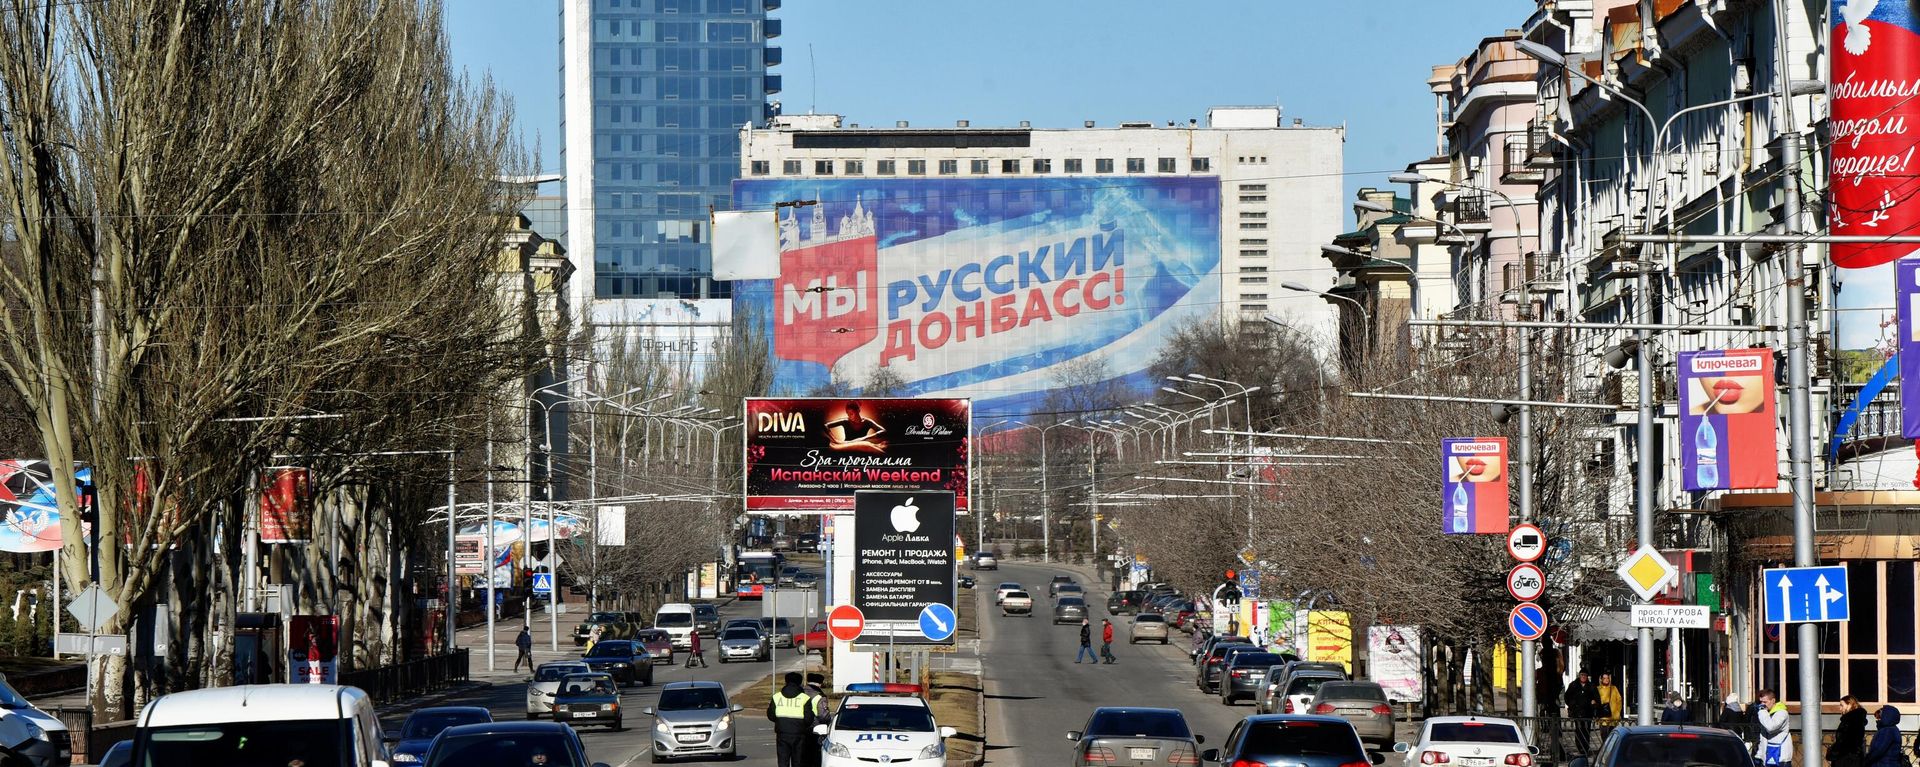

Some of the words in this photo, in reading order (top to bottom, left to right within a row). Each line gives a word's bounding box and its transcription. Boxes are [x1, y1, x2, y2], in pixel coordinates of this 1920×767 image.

[1832, 145, 1915, 187] сердце!
[888, 220, 1125, 320] РУССКИЙ
[784, 269, 868, 326] МЫ
[880, 268, 1125, 367] ДОНБАСС!
[1696, 358, 1757, 370] ключевая
[758, 412, 805, 432] DIVA
[1454, 443, 1497, 453] ключевая
[800, 449, 912, 472] Spa-программа
[771, 468, 861, 481] Испанский
[867, 469, 941, 482] Weekend
[882, 534, 904, 543] Apple
[905, 534, 929, 542] Лавка
[862, 549, 896, 557] РЕМОНТ
[905, 549, 947, 558] ПРОДАЖА
[1667, 608, 1703, 616] ГУРОВА
[298, 666, 330, 675] SALE
[777, 697, 801, 708] ДПС
[856, 733, 909, 742] ДПС
